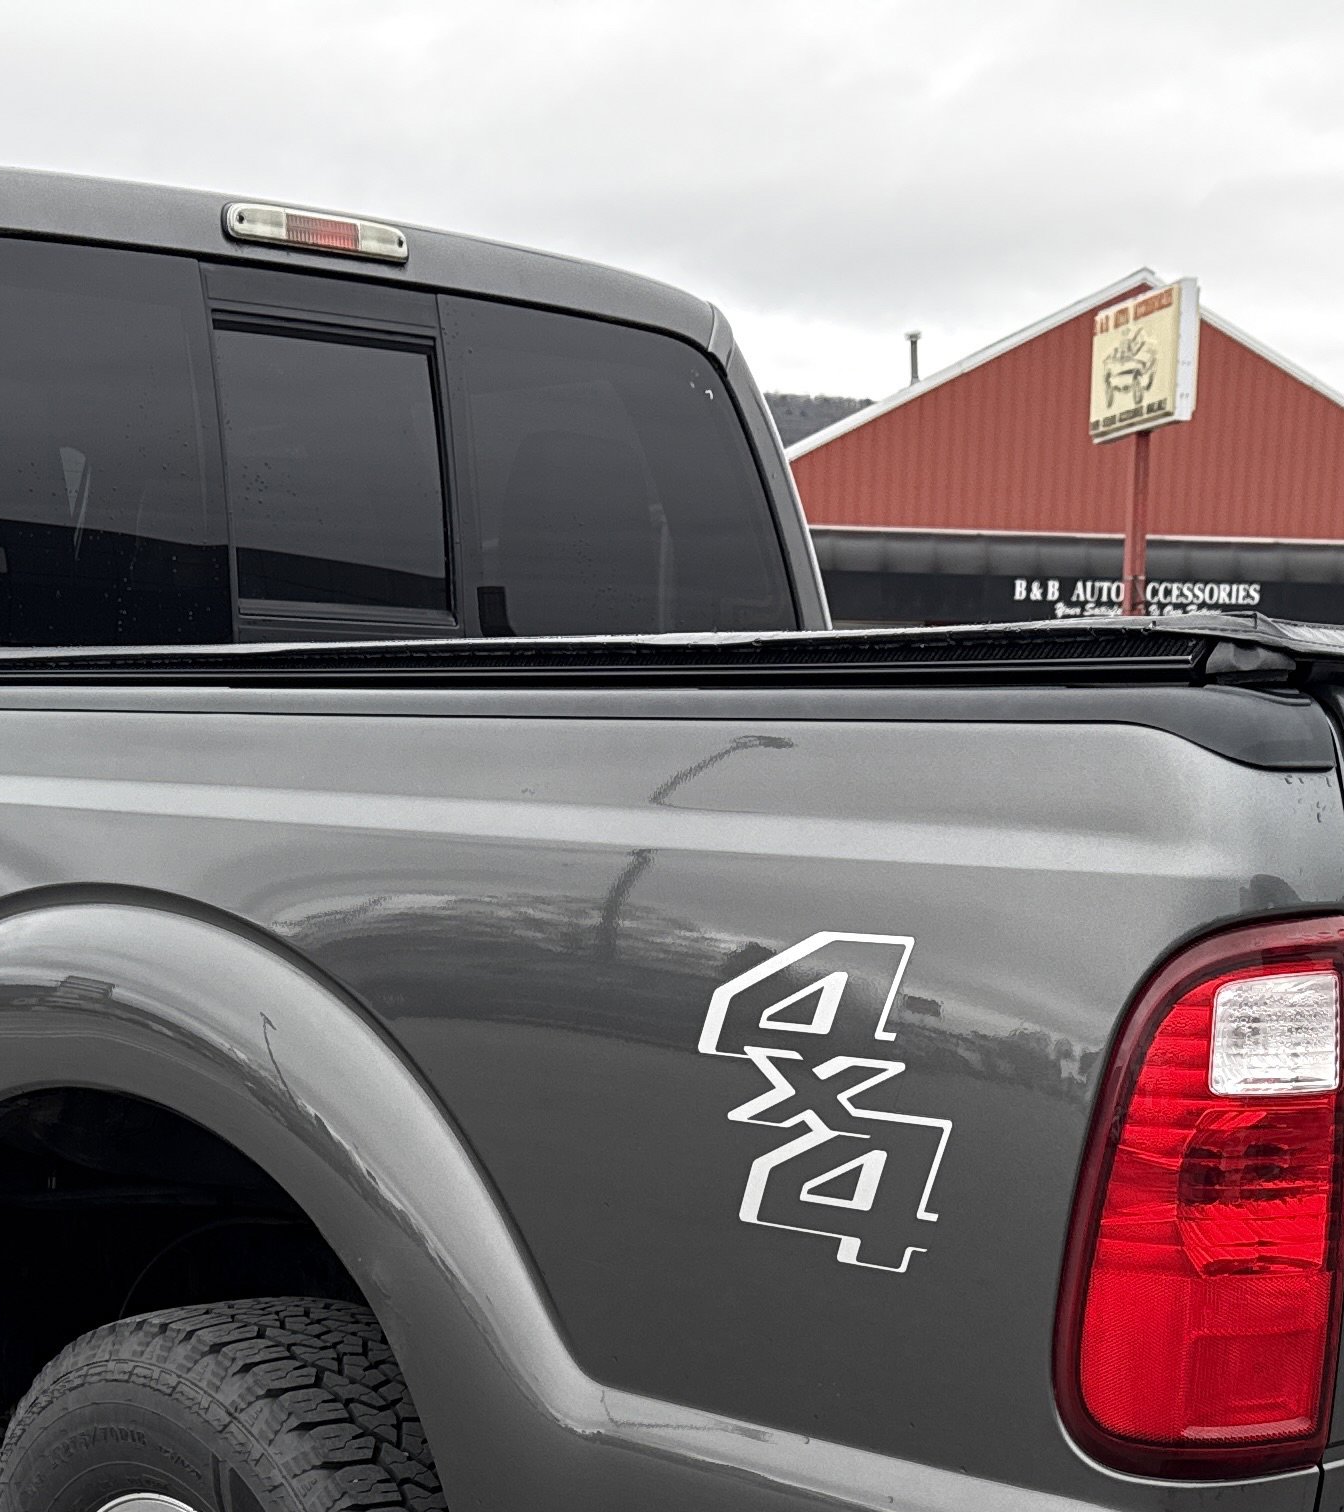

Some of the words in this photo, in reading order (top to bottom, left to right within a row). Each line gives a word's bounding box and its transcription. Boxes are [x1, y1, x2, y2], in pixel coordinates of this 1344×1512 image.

[1014, 579, 1027, 600] B
[1030, 582, 1043, 600] &
[1047, 579, 1060, 600] B
[1071, 579, 1124, 602] AUTO
